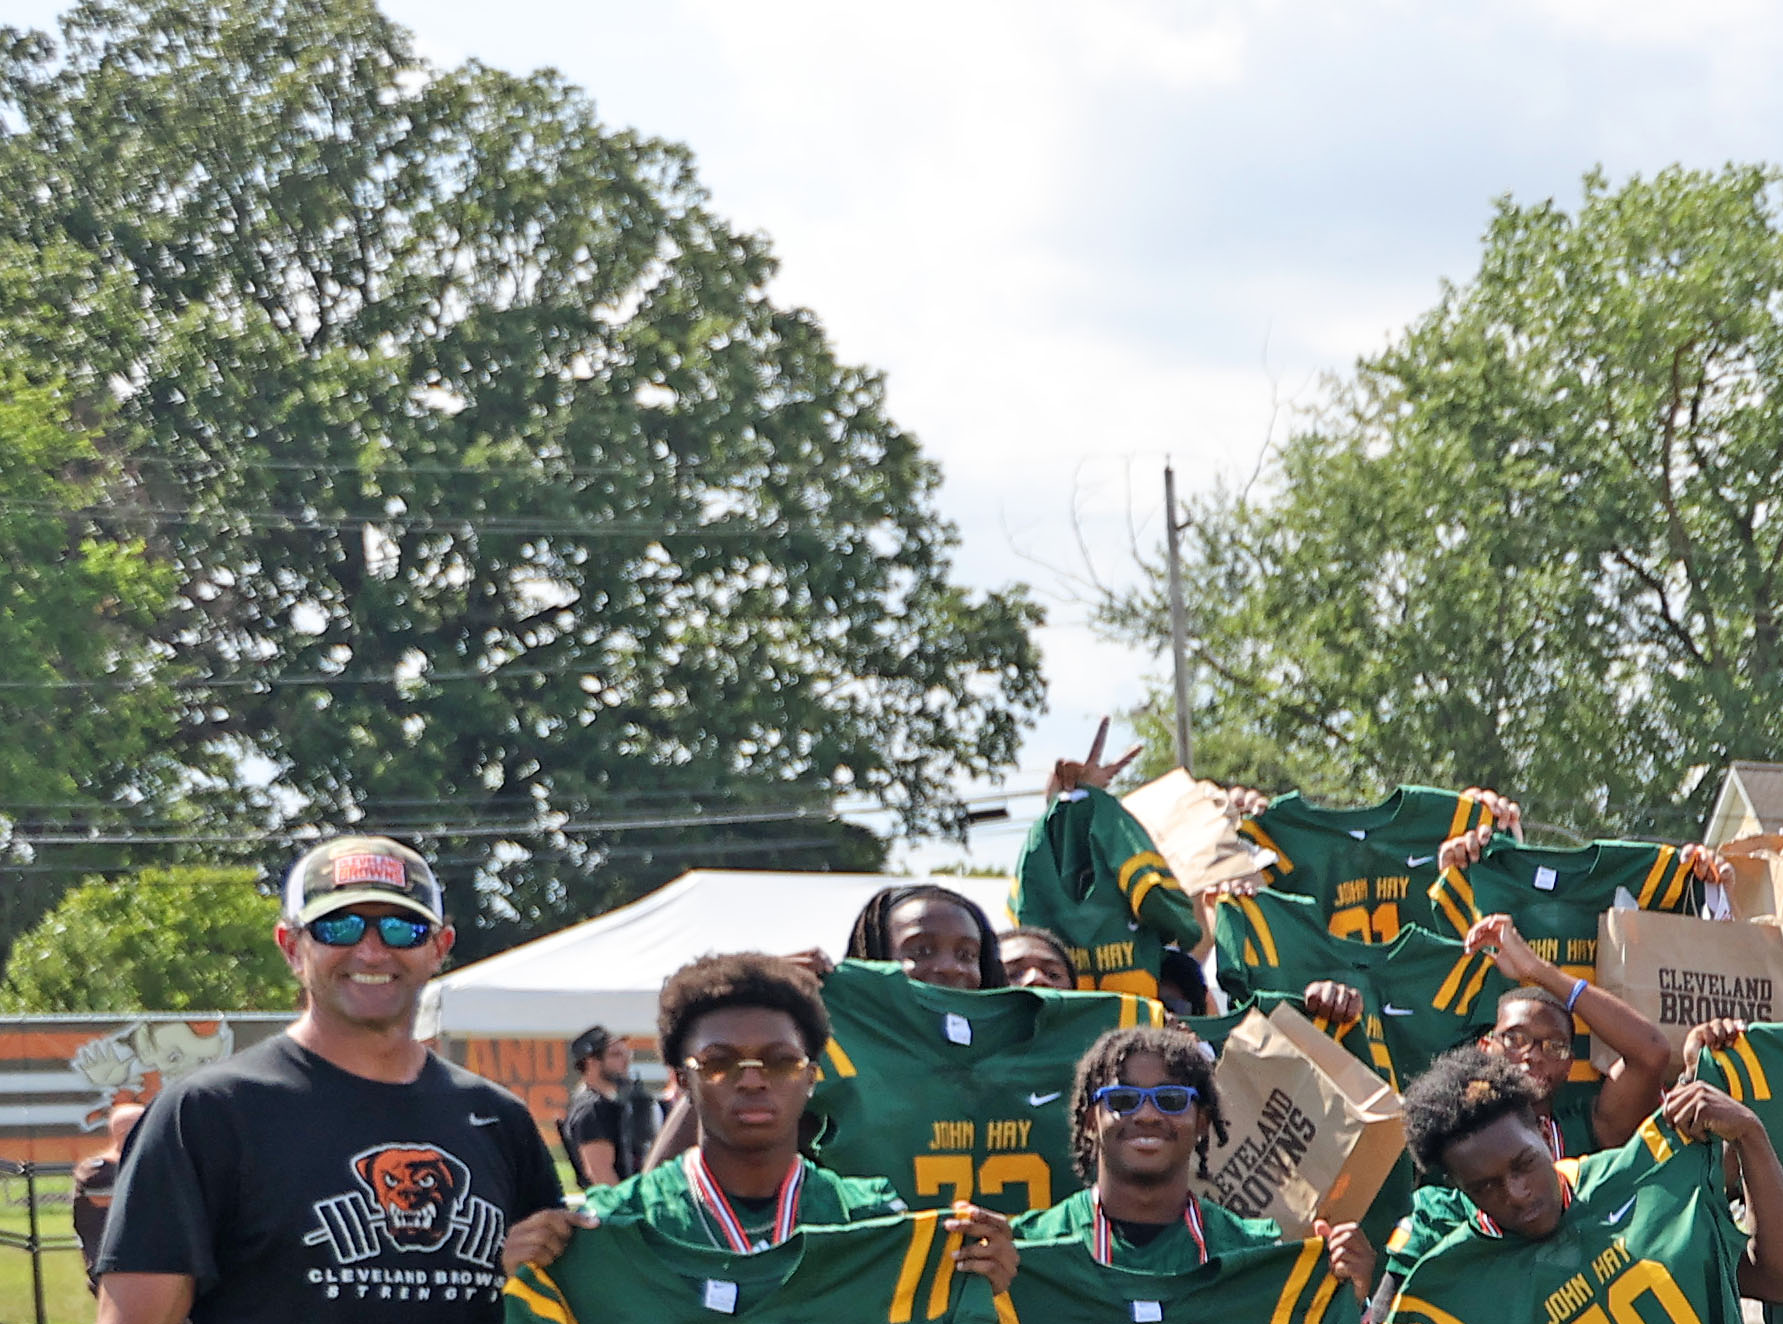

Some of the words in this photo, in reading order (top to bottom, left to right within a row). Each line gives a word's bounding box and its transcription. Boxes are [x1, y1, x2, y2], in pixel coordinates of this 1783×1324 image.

[1096, 942, 1133, 970] HAY
[1528, 938, 1559, 963] OHN
[1659, 967, 1773, 1001] CLEVELAND
[1659, 992, 1773, 1025] BROWNS
[929, 1120, 974, 1150] JOHN
[987, 1119, 1031, 1149] HAY
[1591, 1237, 1631, 1284] HAY
[308, 1269, 427, 1285] CLEVELAND
